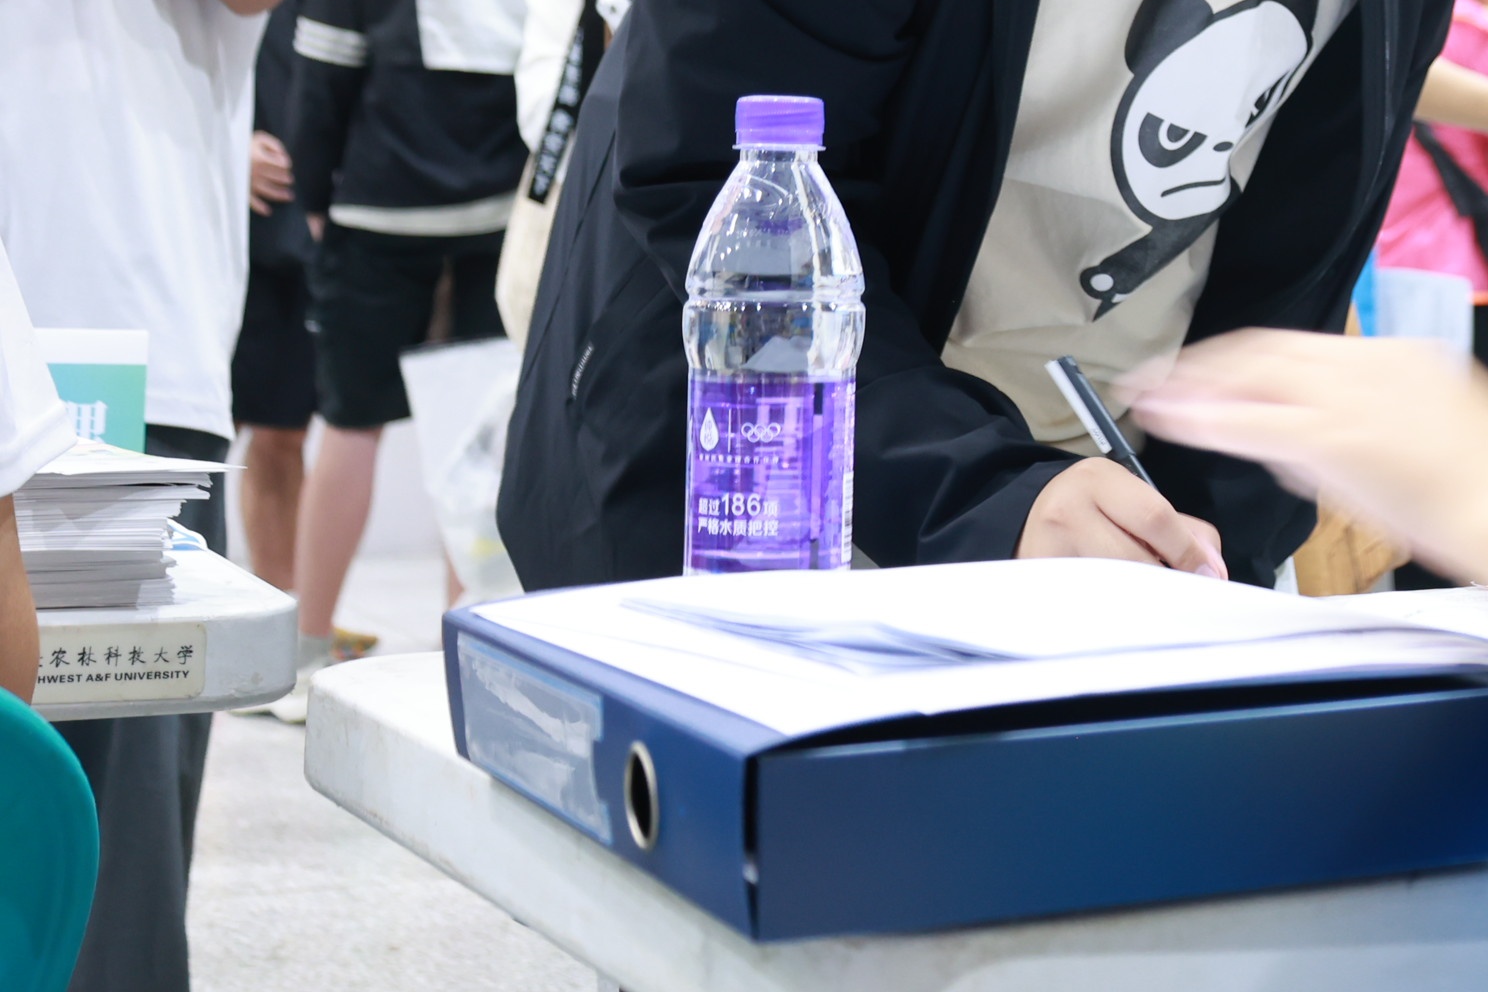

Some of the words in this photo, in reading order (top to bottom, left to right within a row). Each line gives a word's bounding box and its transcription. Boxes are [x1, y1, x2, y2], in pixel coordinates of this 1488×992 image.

[699, 493, 778, 517] 超过186项
[698, 518, 779, 537] 严格水质把控
[38, 645, 194, 669] 农林科技大学
[86, 673, 111, 682] A&F
[115, 670, 190, 681] UNIVERSITY
